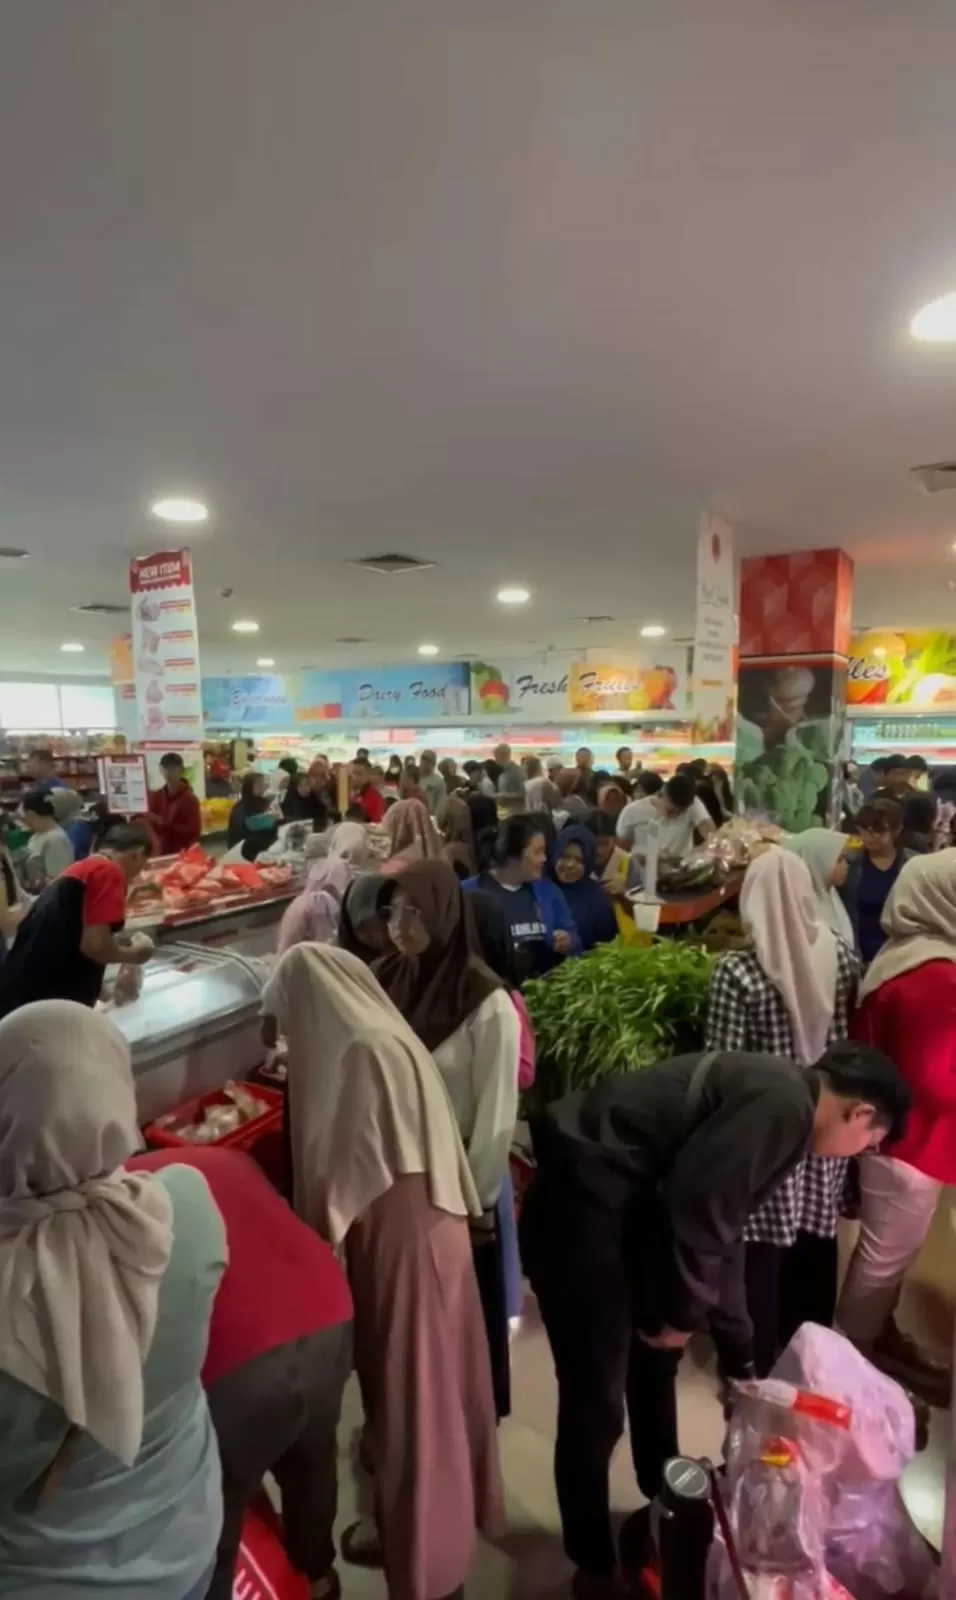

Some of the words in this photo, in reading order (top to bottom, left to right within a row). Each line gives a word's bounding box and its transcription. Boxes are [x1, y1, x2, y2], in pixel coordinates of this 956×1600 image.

[139, 566, 158, 578] NEW
[847, 656, 888, 680] les
[358, 683, 401, 704] Dairy
[409, 681, 448, 703] Food
[516, 674, 568, 698] Fresh
